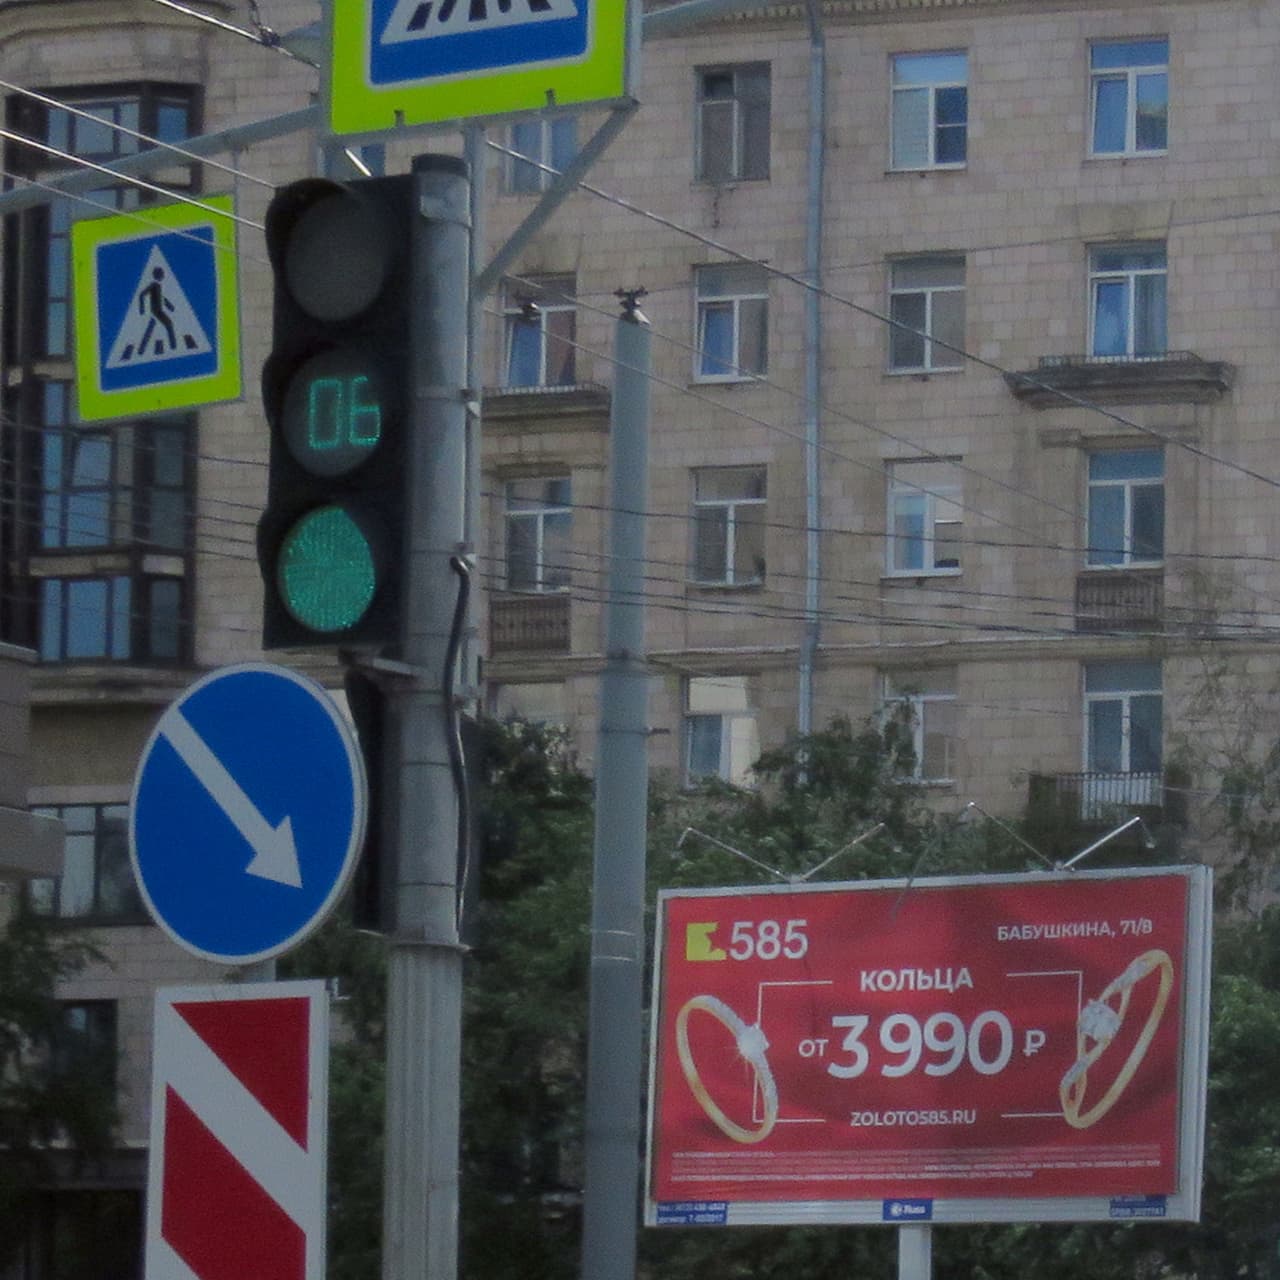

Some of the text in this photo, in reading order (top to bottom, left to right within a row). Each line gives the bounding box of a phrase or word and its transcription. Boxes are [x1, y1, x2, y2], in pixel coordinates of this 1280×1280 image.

[308, 375, 382, 449] 06
[729, 919, 809, 961] 585
[860, 967, 974, 993] КОЛЬЦА
[850, 1110, 977, 1127] ZOLOTO585.RU
